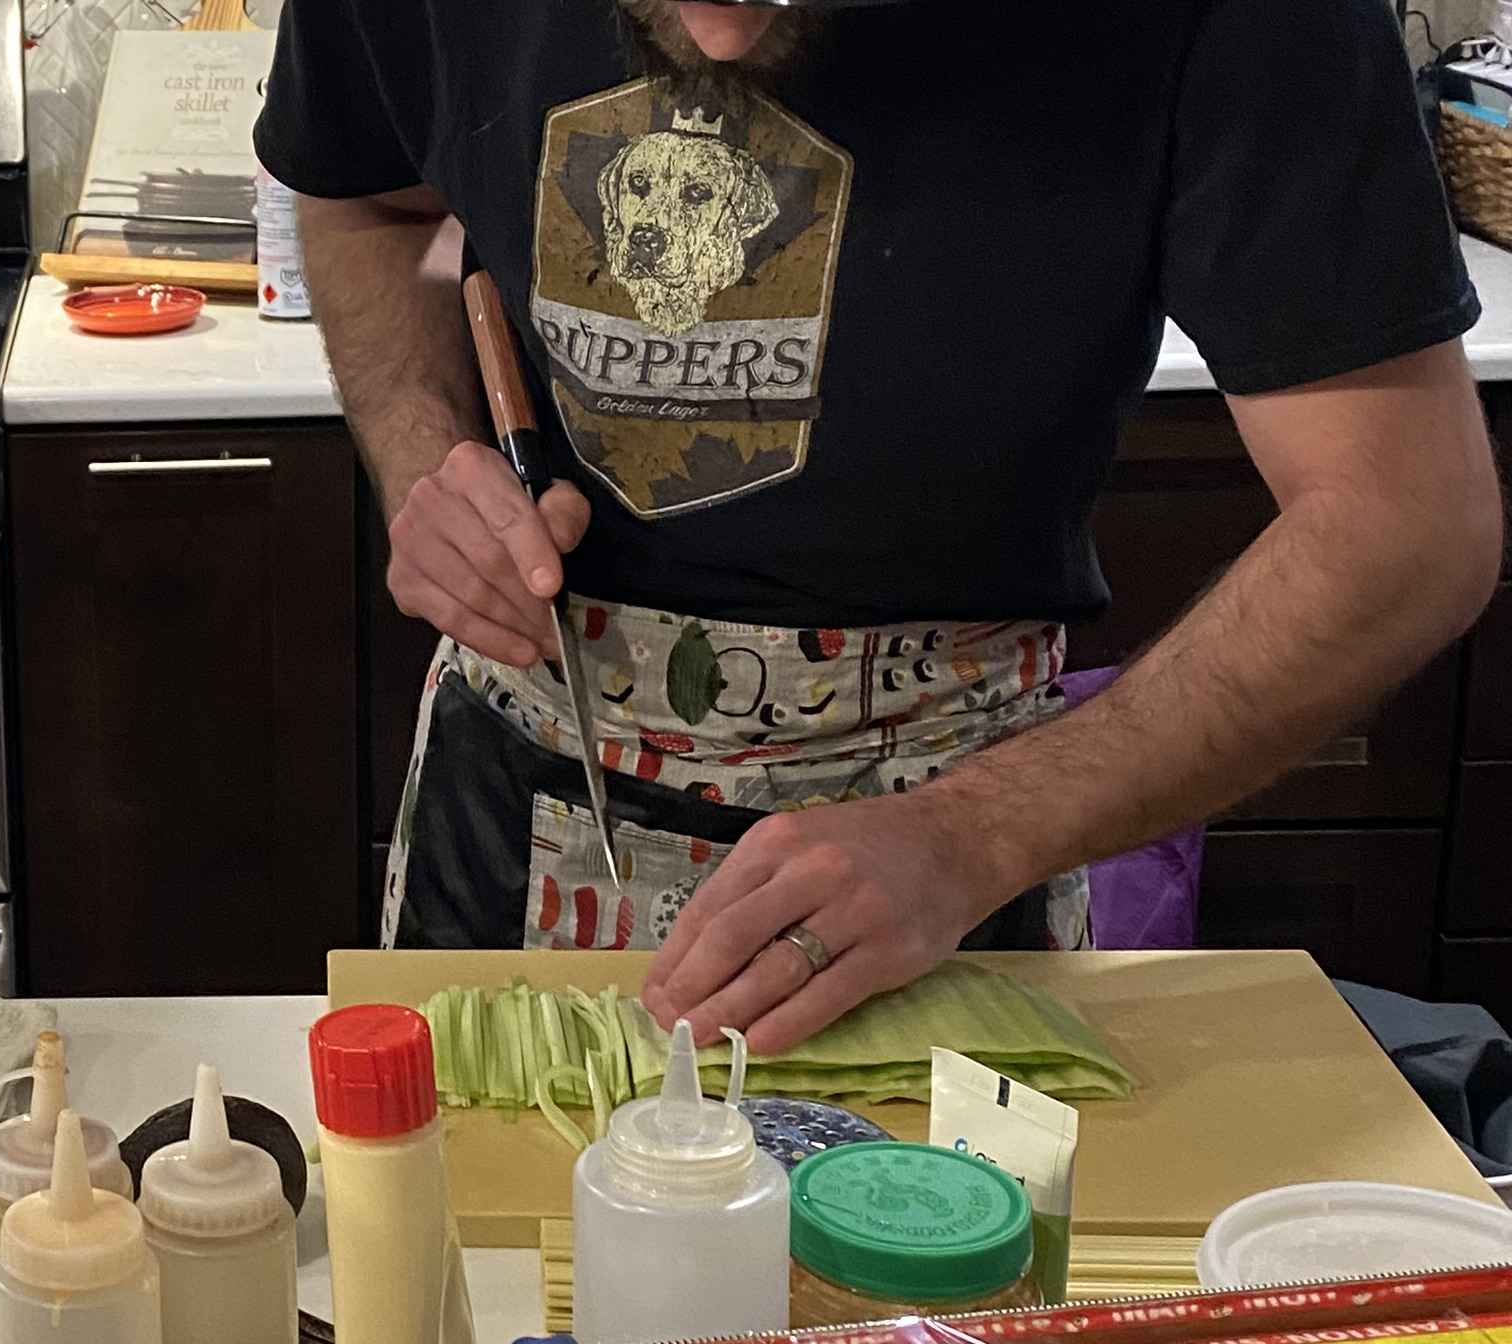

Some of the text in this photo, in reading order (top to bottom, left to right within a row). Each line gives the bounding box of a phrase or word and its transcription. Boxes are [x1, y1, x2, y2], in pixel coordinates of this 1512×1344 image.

[164, 72, 245, 91] cast iron
[174, 92, 231, 113] skillet
[540, 318, 812, 392] PUPPERS
